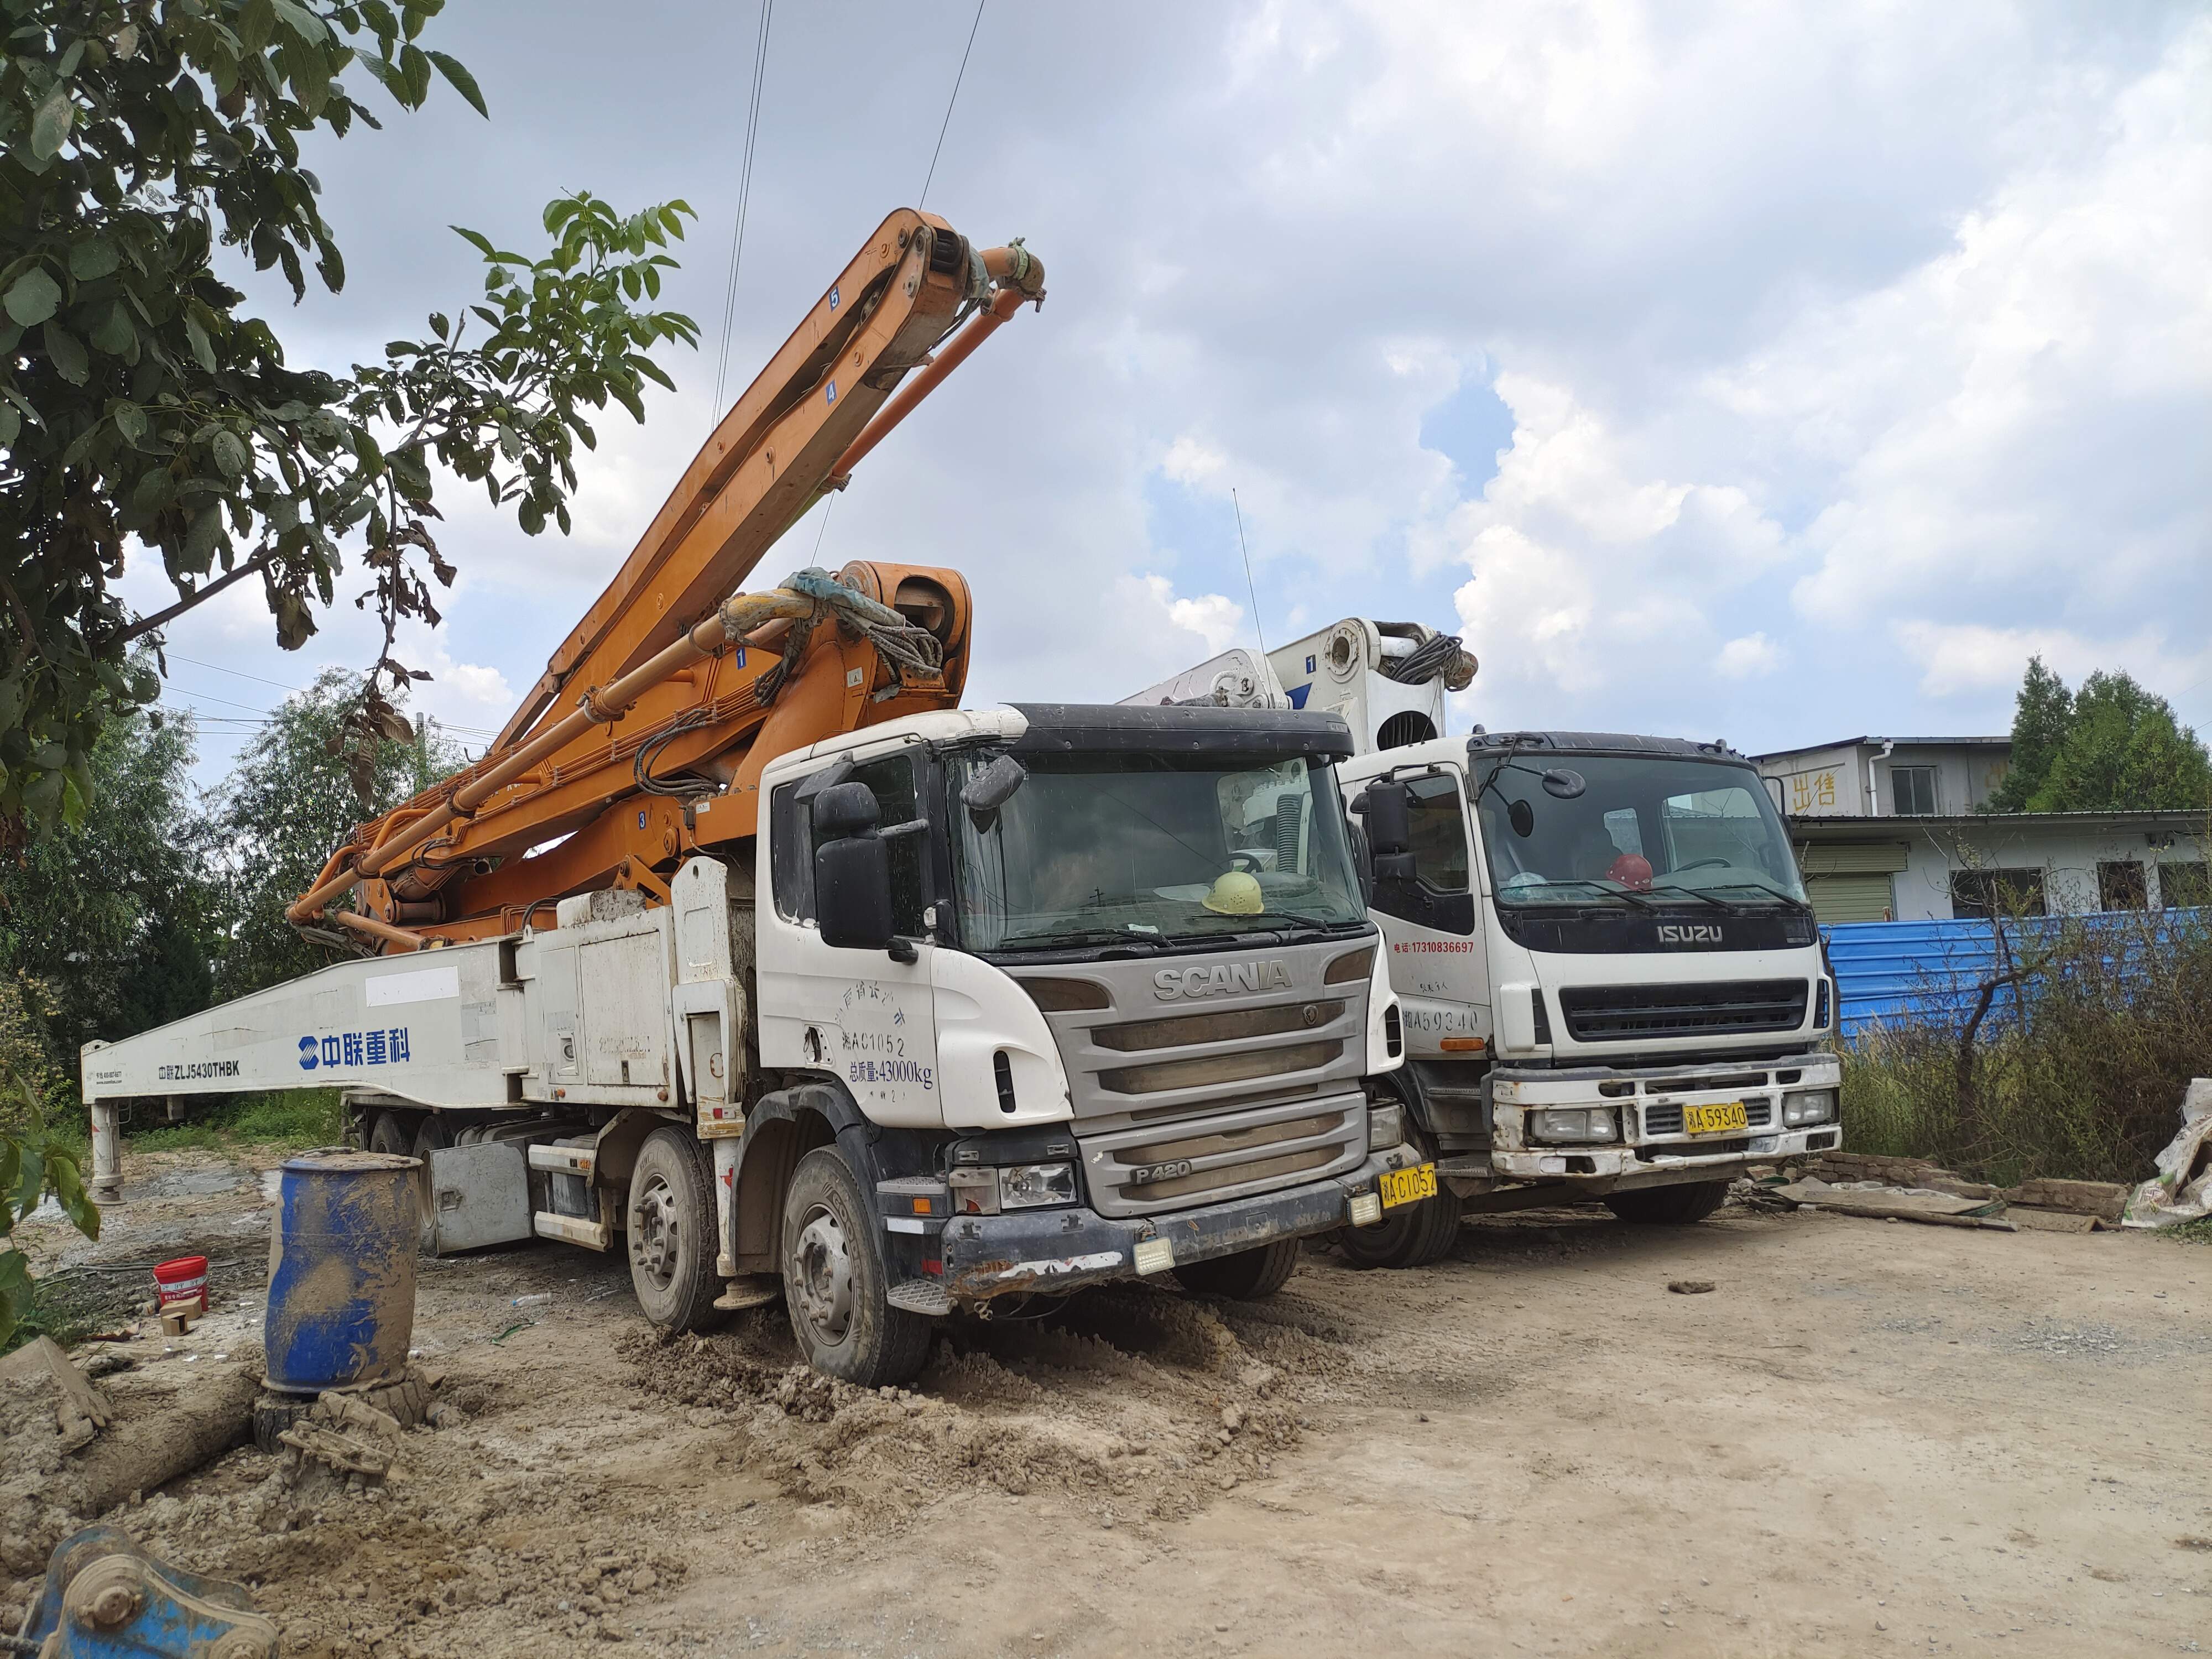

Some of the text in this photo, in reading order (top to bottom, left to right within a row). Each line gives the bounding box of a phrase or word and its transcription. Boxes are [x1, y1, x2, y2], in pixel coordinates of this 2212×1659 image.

[831, 288, 838, 307] 5
[828, 383, 835, 400] 4
[1793, 773, 1834, 811] 出售
[639, 812, 645, 828] 3
[1657, 925, 1723, 942] ISUZU
[1154, 959, 1293, 1000] SCANIA
[322, 1027, 410, 1068] 中联重科
